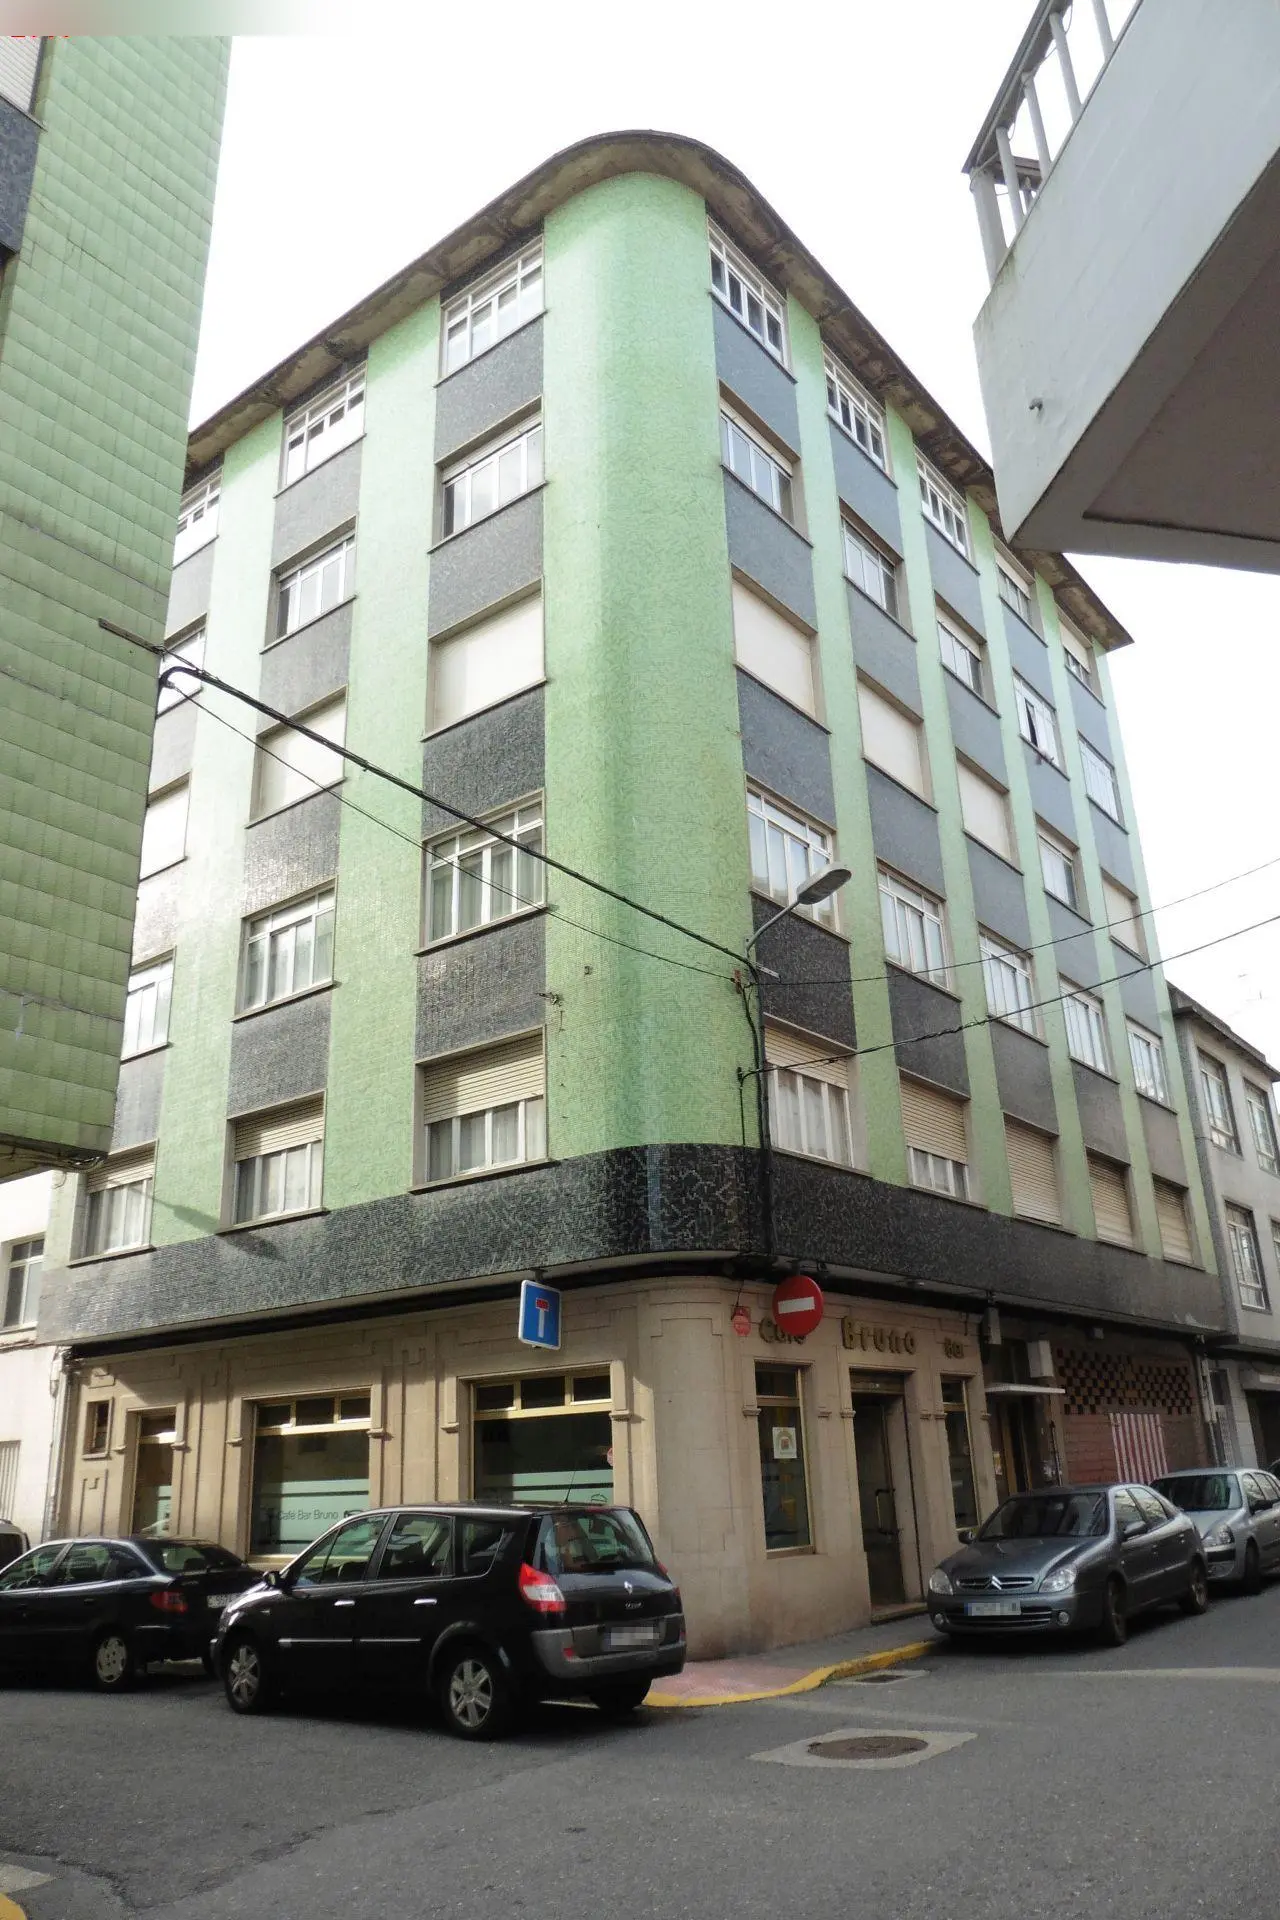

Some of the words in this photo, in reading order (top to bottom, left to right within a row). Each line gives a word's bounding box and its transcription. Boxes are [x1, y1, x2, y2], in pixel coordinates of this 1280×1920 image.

[758, 1316, 806, 1345] Ca
[840, 1315, 917, 1355] Bruno
[297, 1509, 312, 1521] Bar
[313, 1508, 339, 1520] Bruno
